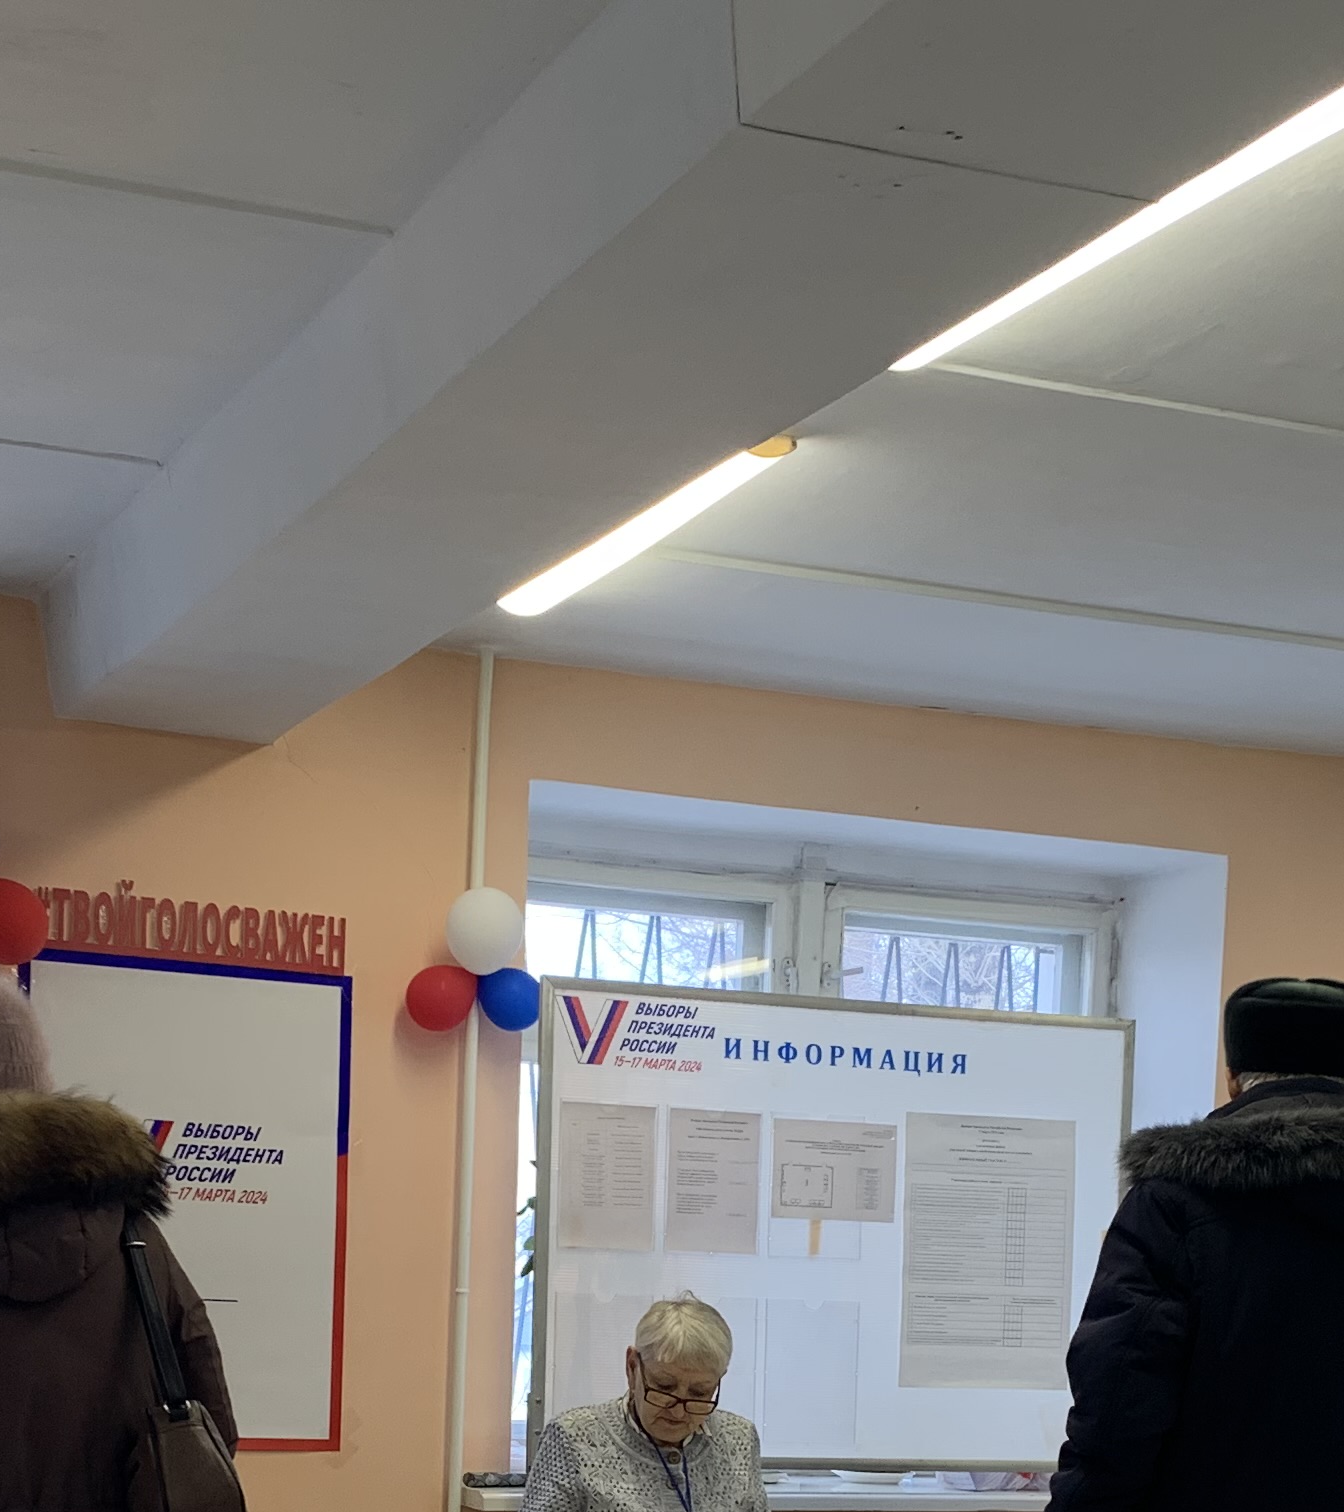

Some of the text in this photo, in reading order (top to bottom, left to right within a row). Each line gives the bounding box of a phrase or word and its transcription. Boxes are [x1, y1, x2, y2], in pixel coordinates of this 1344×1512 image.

[635, 1002, 699, 1020] ВЫБОРЫ
[627, 1019, 716, 1040] ПРЕЗИДЕНТА
[619, 1038, 678, 1055] РОССИИ
[642, 1057, 676, 1071] МАРТА
[677, 1060, 703, 1073] 2024
[723, 1037, 967, 1077] ИНФОРМАЦИЯ
[182, 1122, 262, 1142] ВЫБОРЫ
[173, 1143, 284, 1165] ПРЕЗИДЕНТА
[164, 1165, 236, 1184] РОССИИ
[192, 1188, 236, 1203] МАРТА
[237, 1190, 269, 1204] 2024
